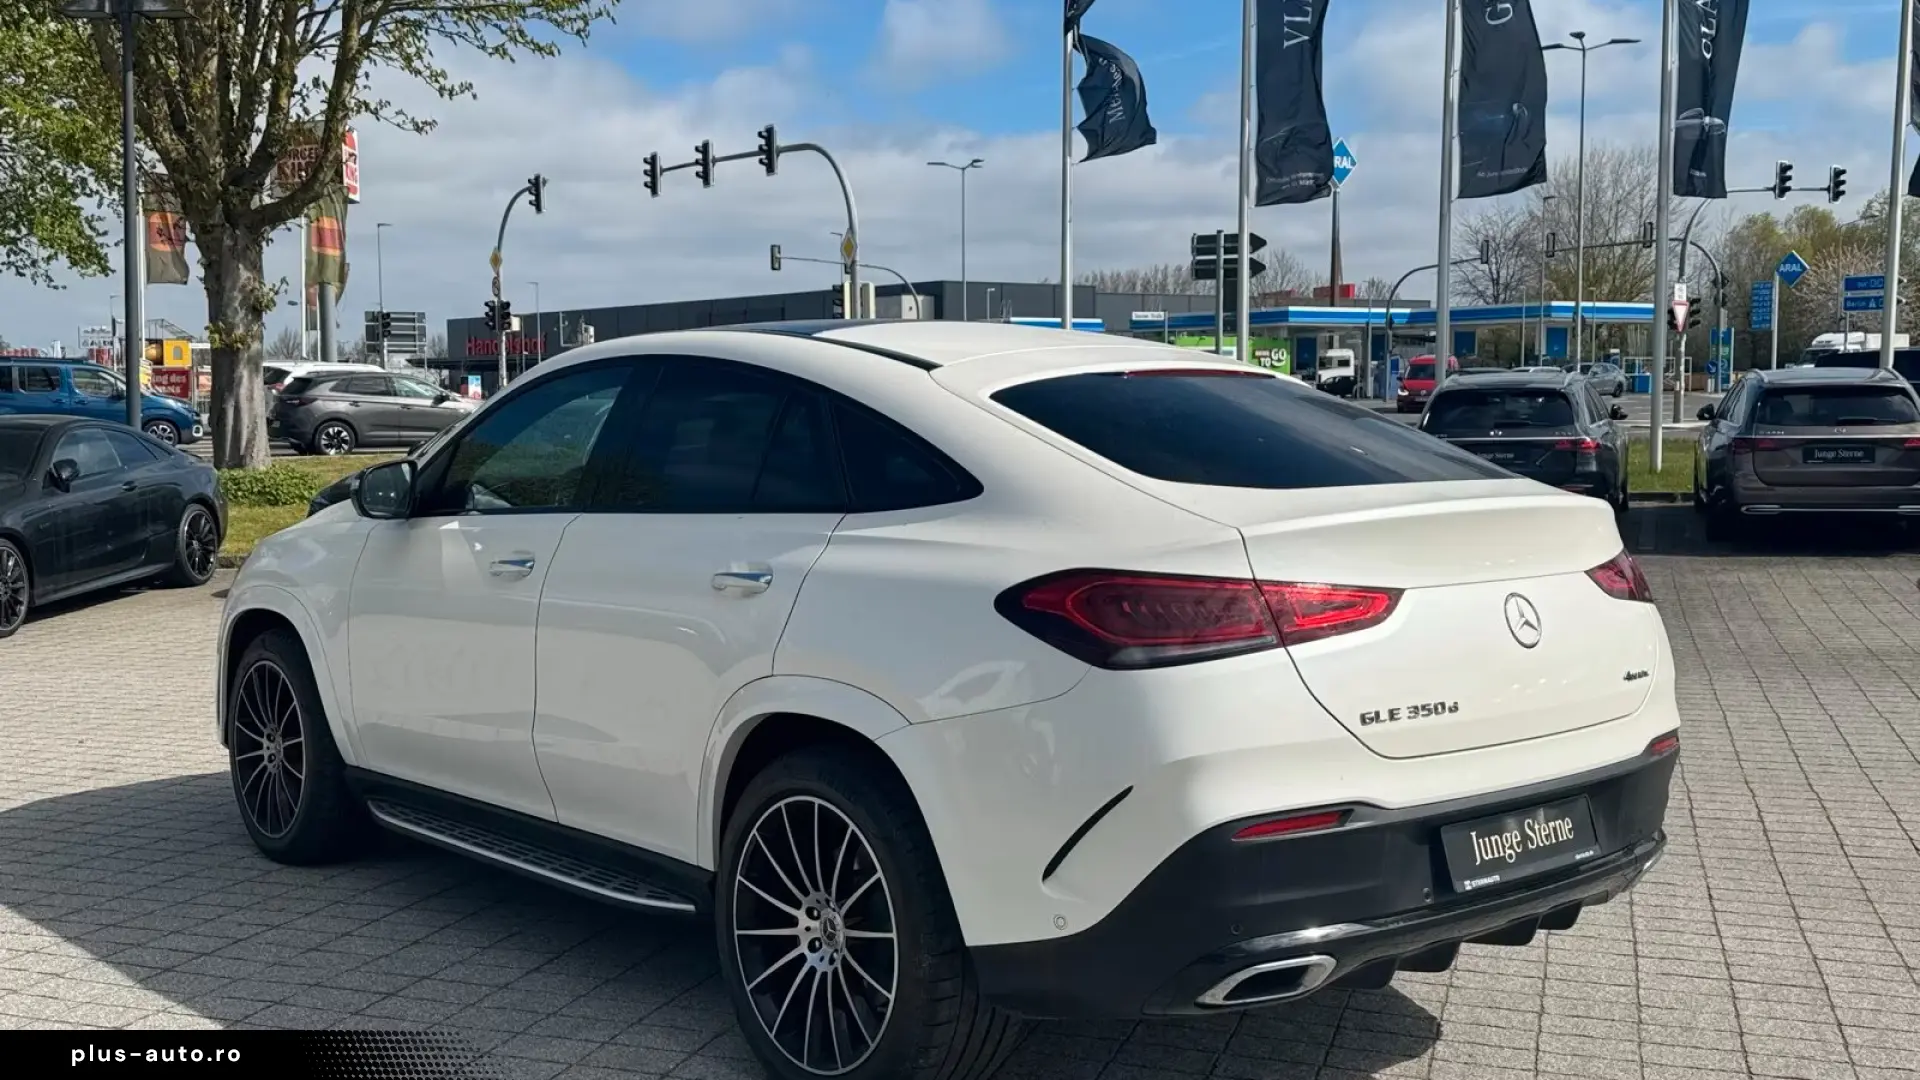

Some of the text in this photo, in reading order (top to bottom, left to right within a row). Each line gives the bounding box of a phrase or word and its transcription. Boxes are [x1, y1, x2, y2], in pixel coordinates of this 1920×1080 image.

[1283, 0, 1312, 49] VL
[1333, 156, 1353, 168] RAL
[1779, 263, 1802, 273] ARAL
[1271, 348, 1286, 360] GO
[1360, 707, 1402, 726] GLE
[1470, 817, 1574, 866] Junge Sterne
